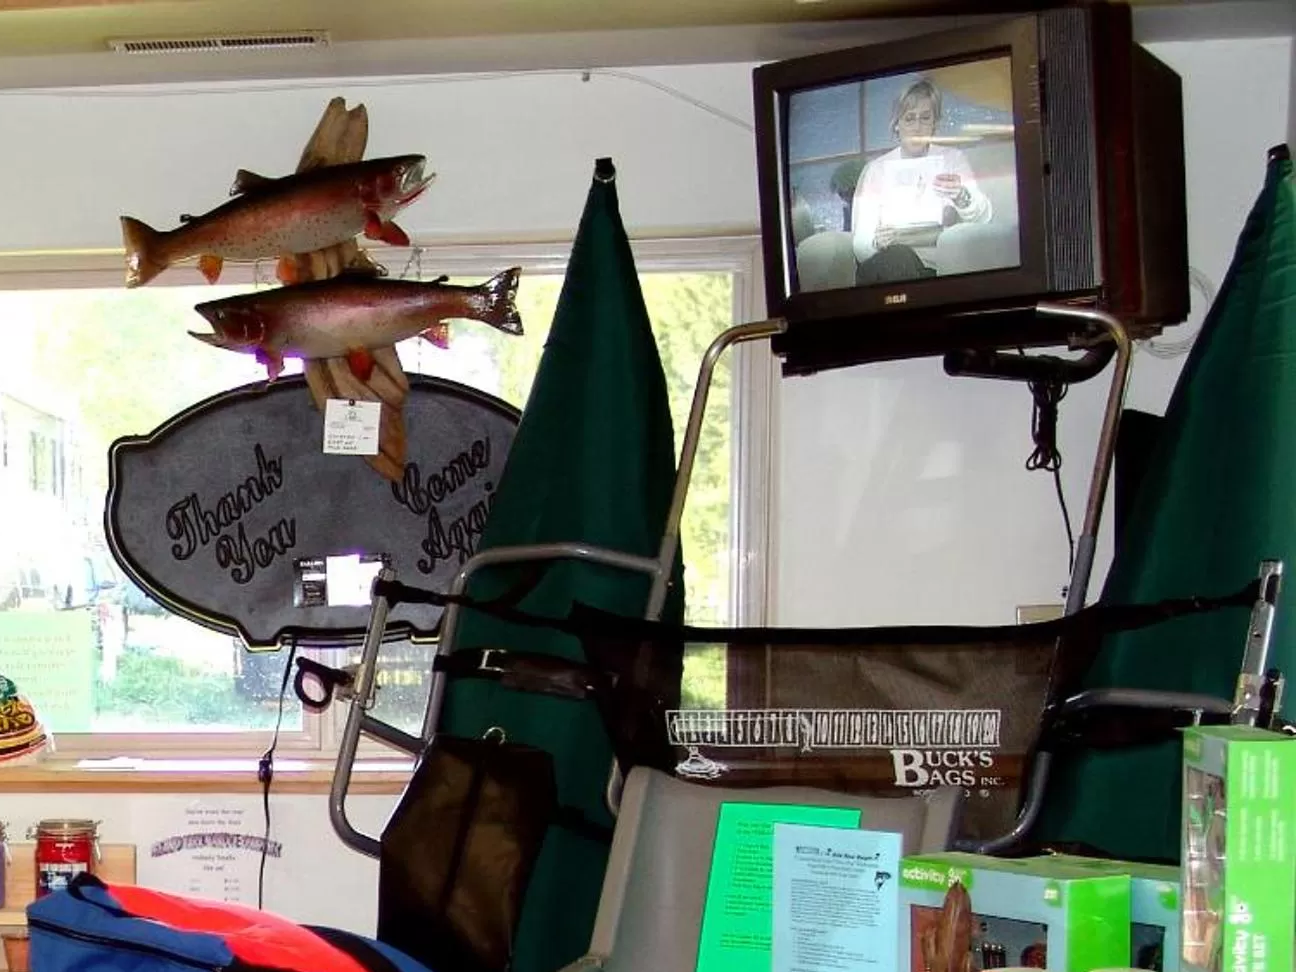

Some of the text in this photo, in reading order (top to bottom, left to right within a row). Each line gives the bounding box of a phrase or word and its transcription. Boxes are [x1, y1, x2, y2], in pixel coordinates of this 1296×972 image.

[165, 443, 284, 561] Thank
[392, 435, 491, 515] Come
[215, 517, 296, 584] You
[417, 483, 497, 575] Agai
